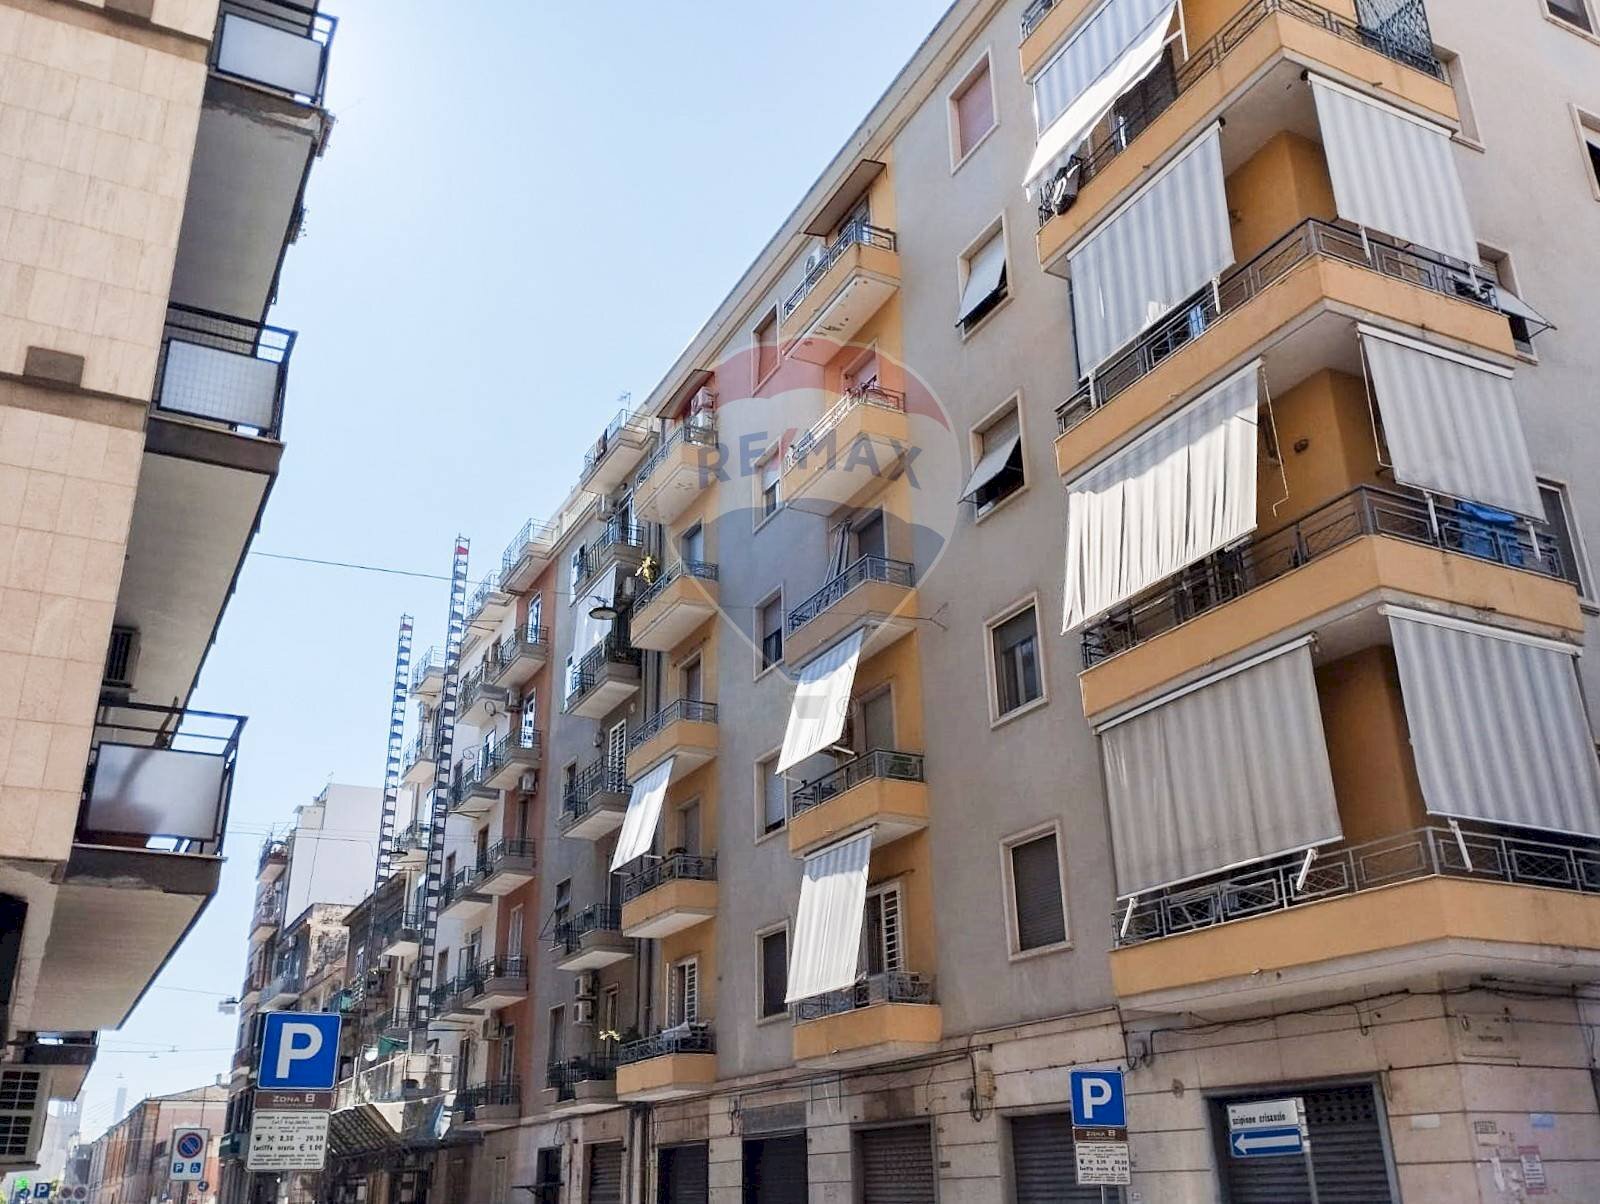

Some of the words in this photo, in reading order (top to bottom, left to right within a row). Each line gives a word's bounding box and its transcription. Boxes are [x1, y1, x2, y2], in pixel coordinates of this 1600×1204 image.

[276, 1022, 323, 1079] P
[305, 1093, 316, 1103] B
[1082, 1078, 1112, 1119] P
[36, 1184, 48, 1196] P
